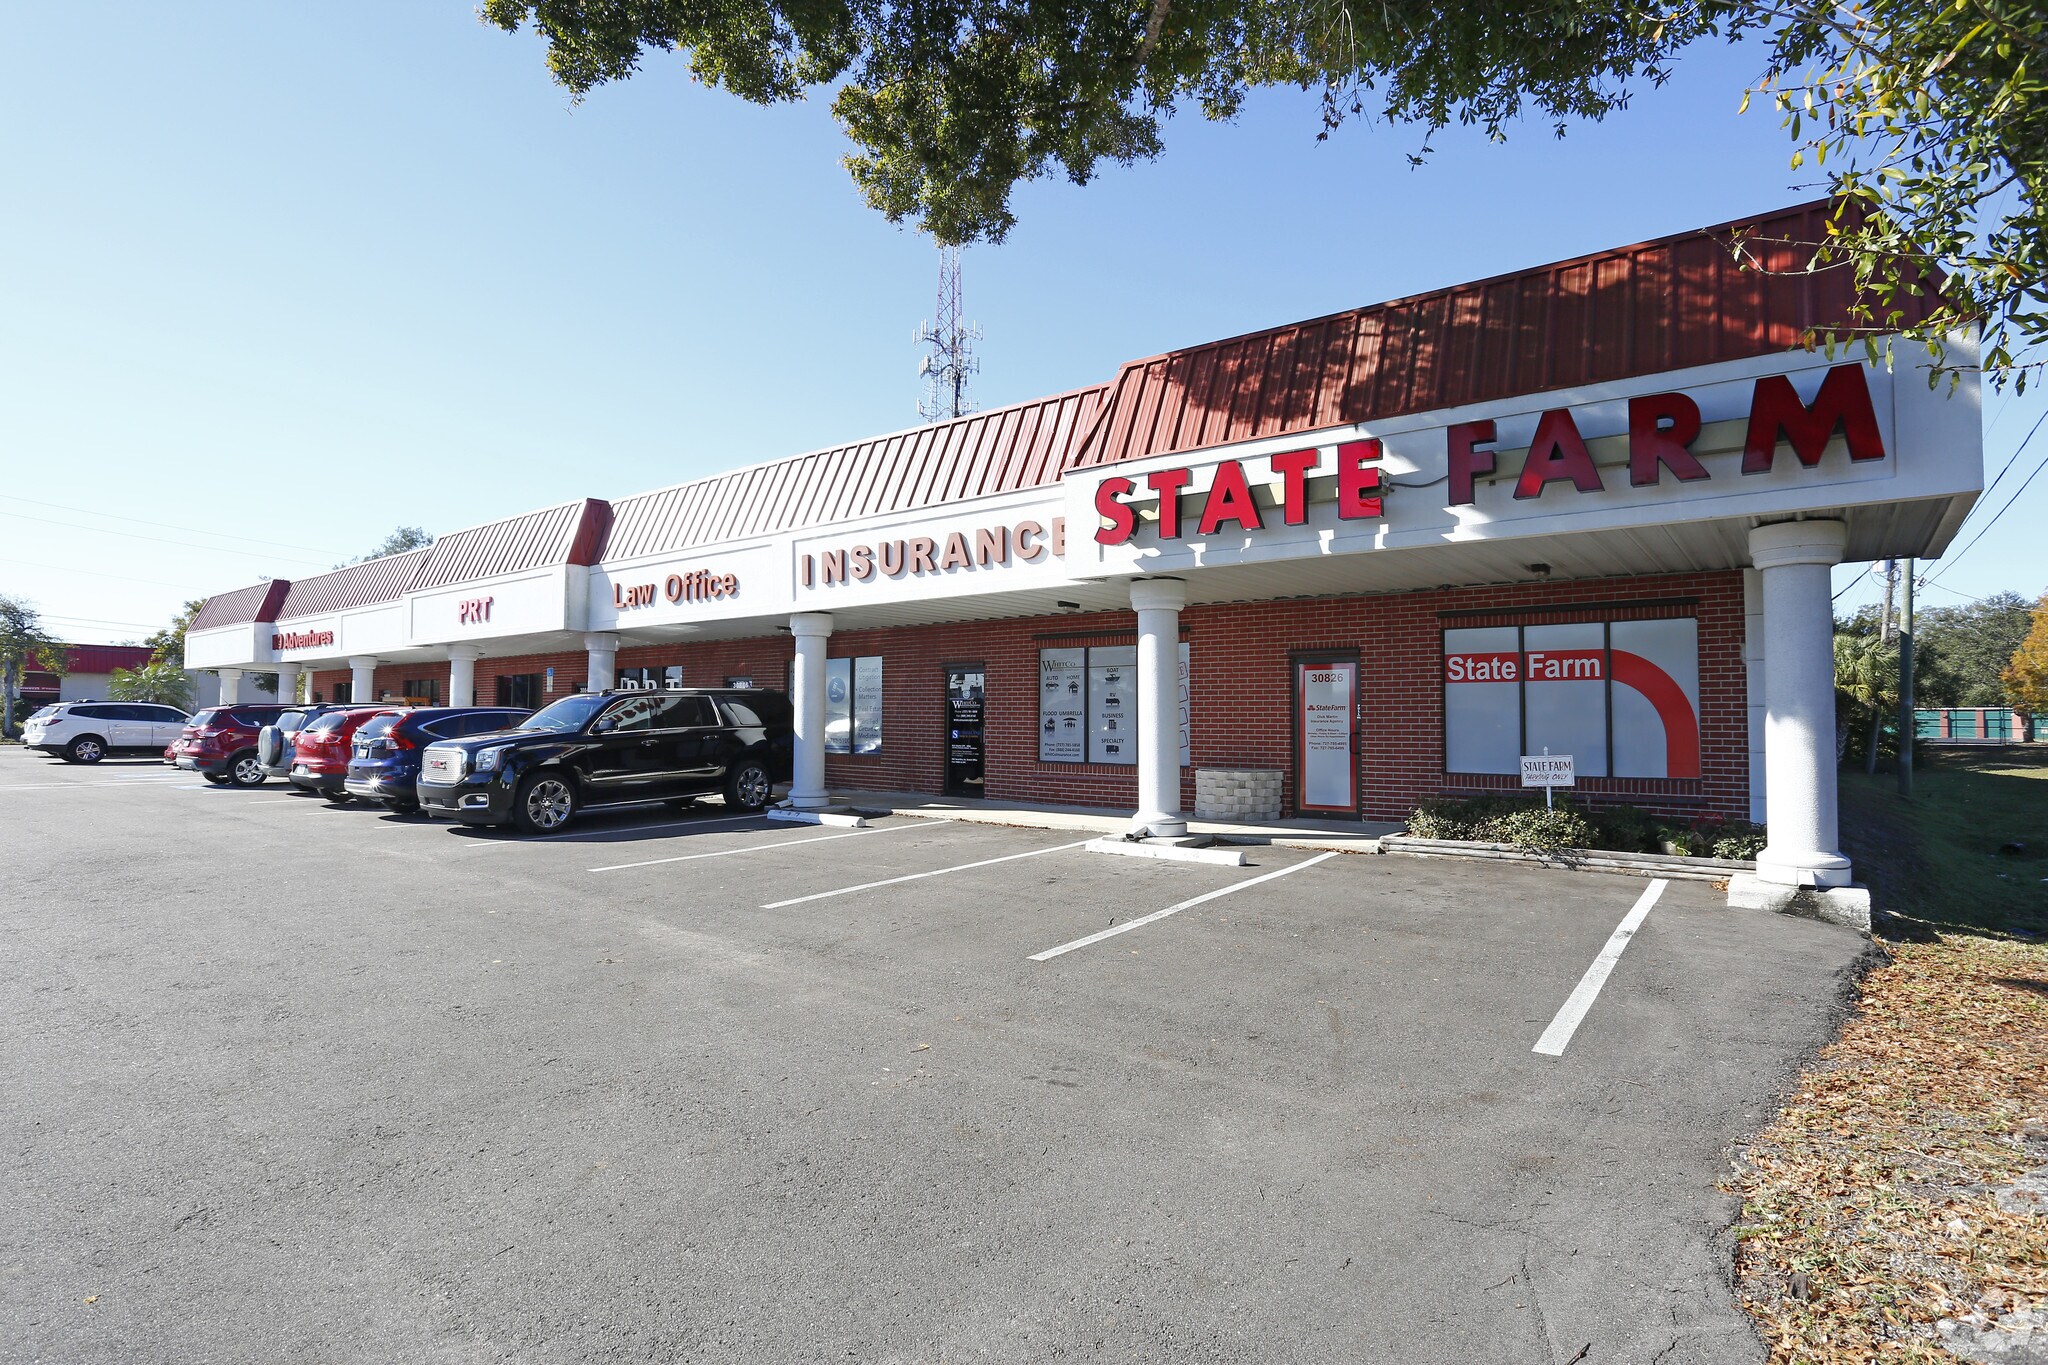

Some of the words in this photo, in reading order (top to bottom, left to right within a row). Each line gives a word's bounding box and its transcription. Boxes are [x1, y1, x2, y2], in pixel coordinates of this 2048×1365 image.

[1094, 437, 1384, 546] STATE
[1448, 362, 1884, 506] FARM
[614, 583, 656, 608] Law
[664, 569, 738, 603] Office
[458, 596, 494, 625] PRT
[284, 629, 334, 649] Adventures
[1311, 673, 1344, 683] 30826
[1447, 656, 1517, 681] State
[1528, 653, 1600, 679] Farm
[1523, 761, 1547, 772] STATE
[1549, 760, 1571, 772] FARM
[1551, 773, 1569, 781] ONLY
